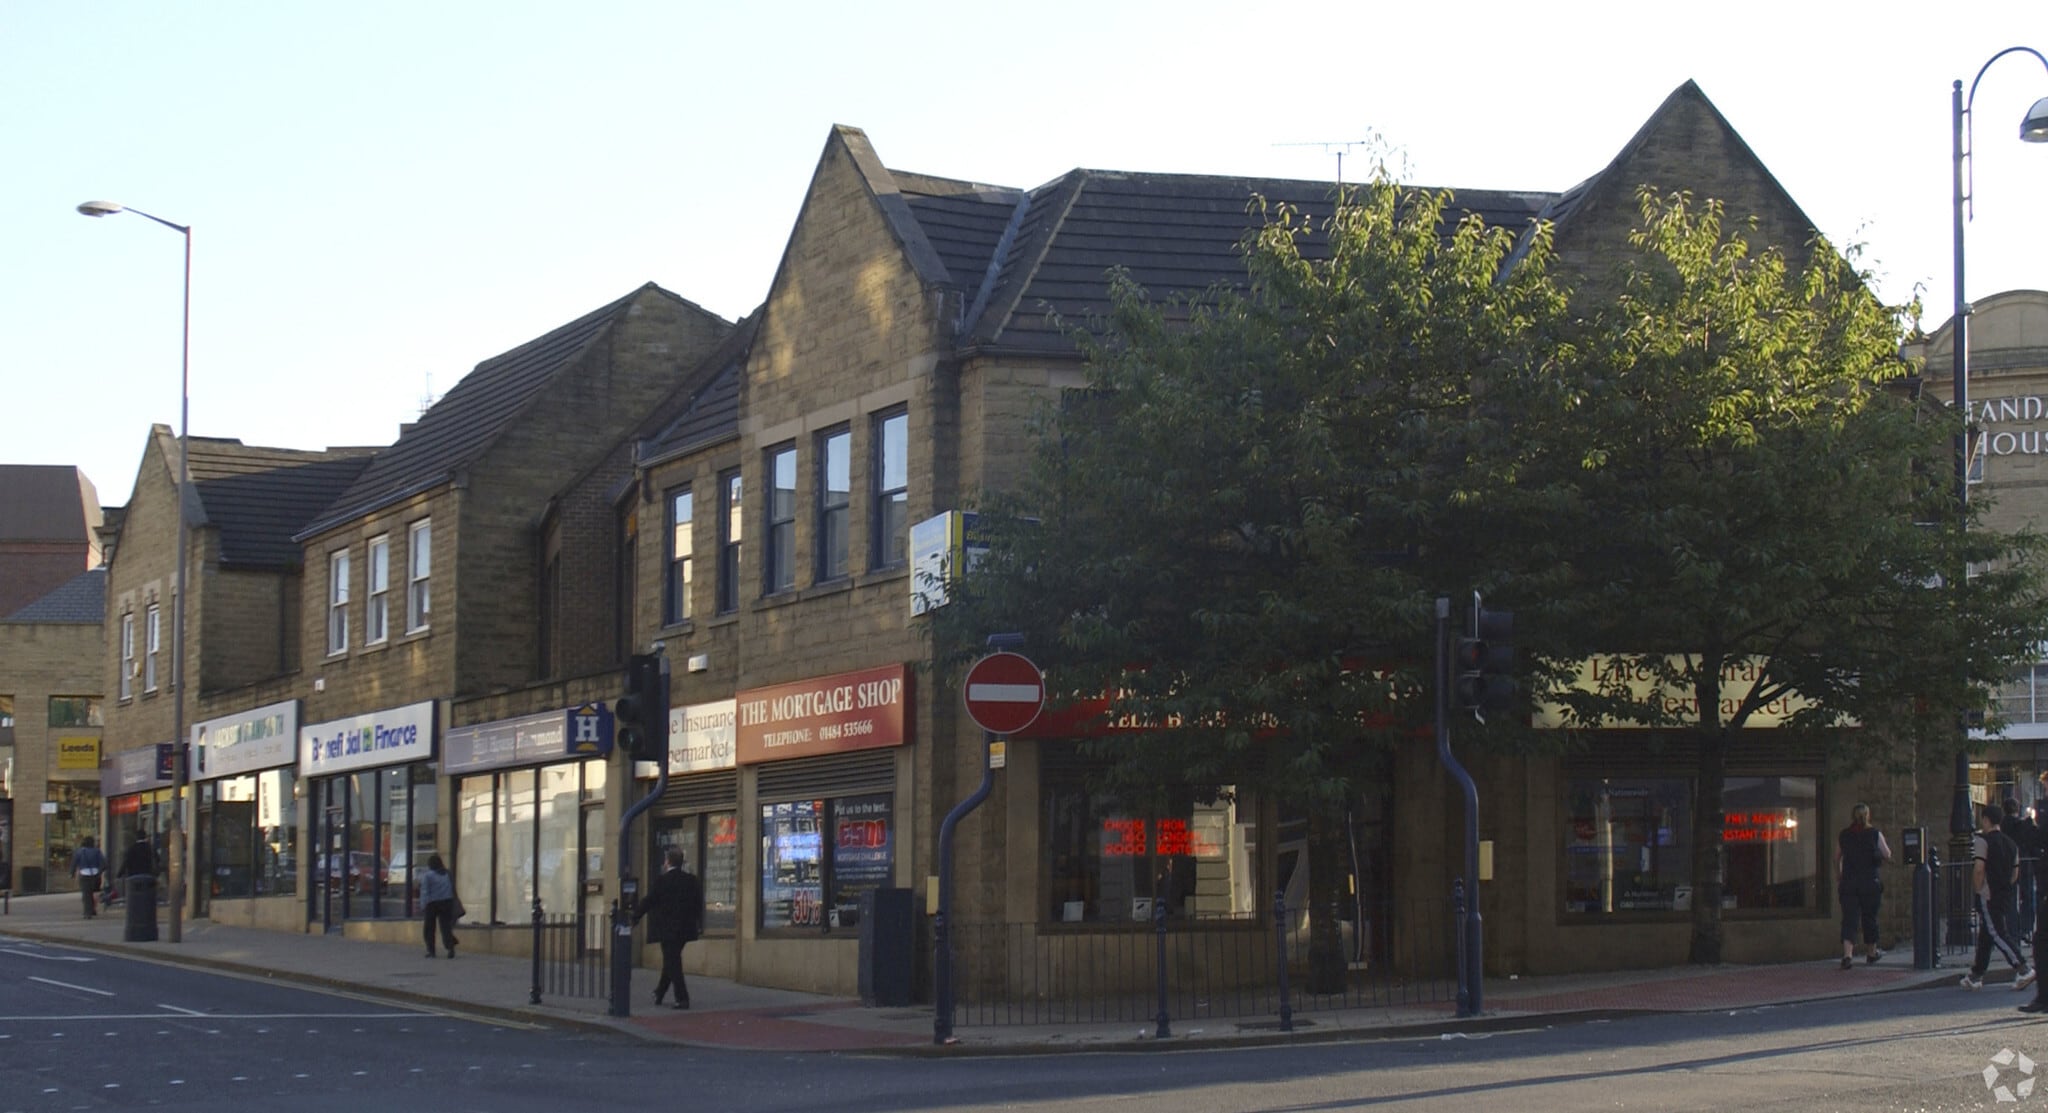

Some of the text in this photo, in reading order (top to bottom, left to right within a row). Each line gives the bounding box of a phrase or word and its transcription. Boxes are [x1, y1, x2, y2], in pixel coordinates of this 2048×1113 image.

[740, 678, 901, 727] THE MORTGAGE SHOP
[575, 715, 600, 742] H
[681, 711, 736, 734] Insuranc
[763, 719, 873, 748] TELEPHONE: 01484 535666
[61, 743, 95, 753] Leeds
[375, 724, 417, 750] Finance
